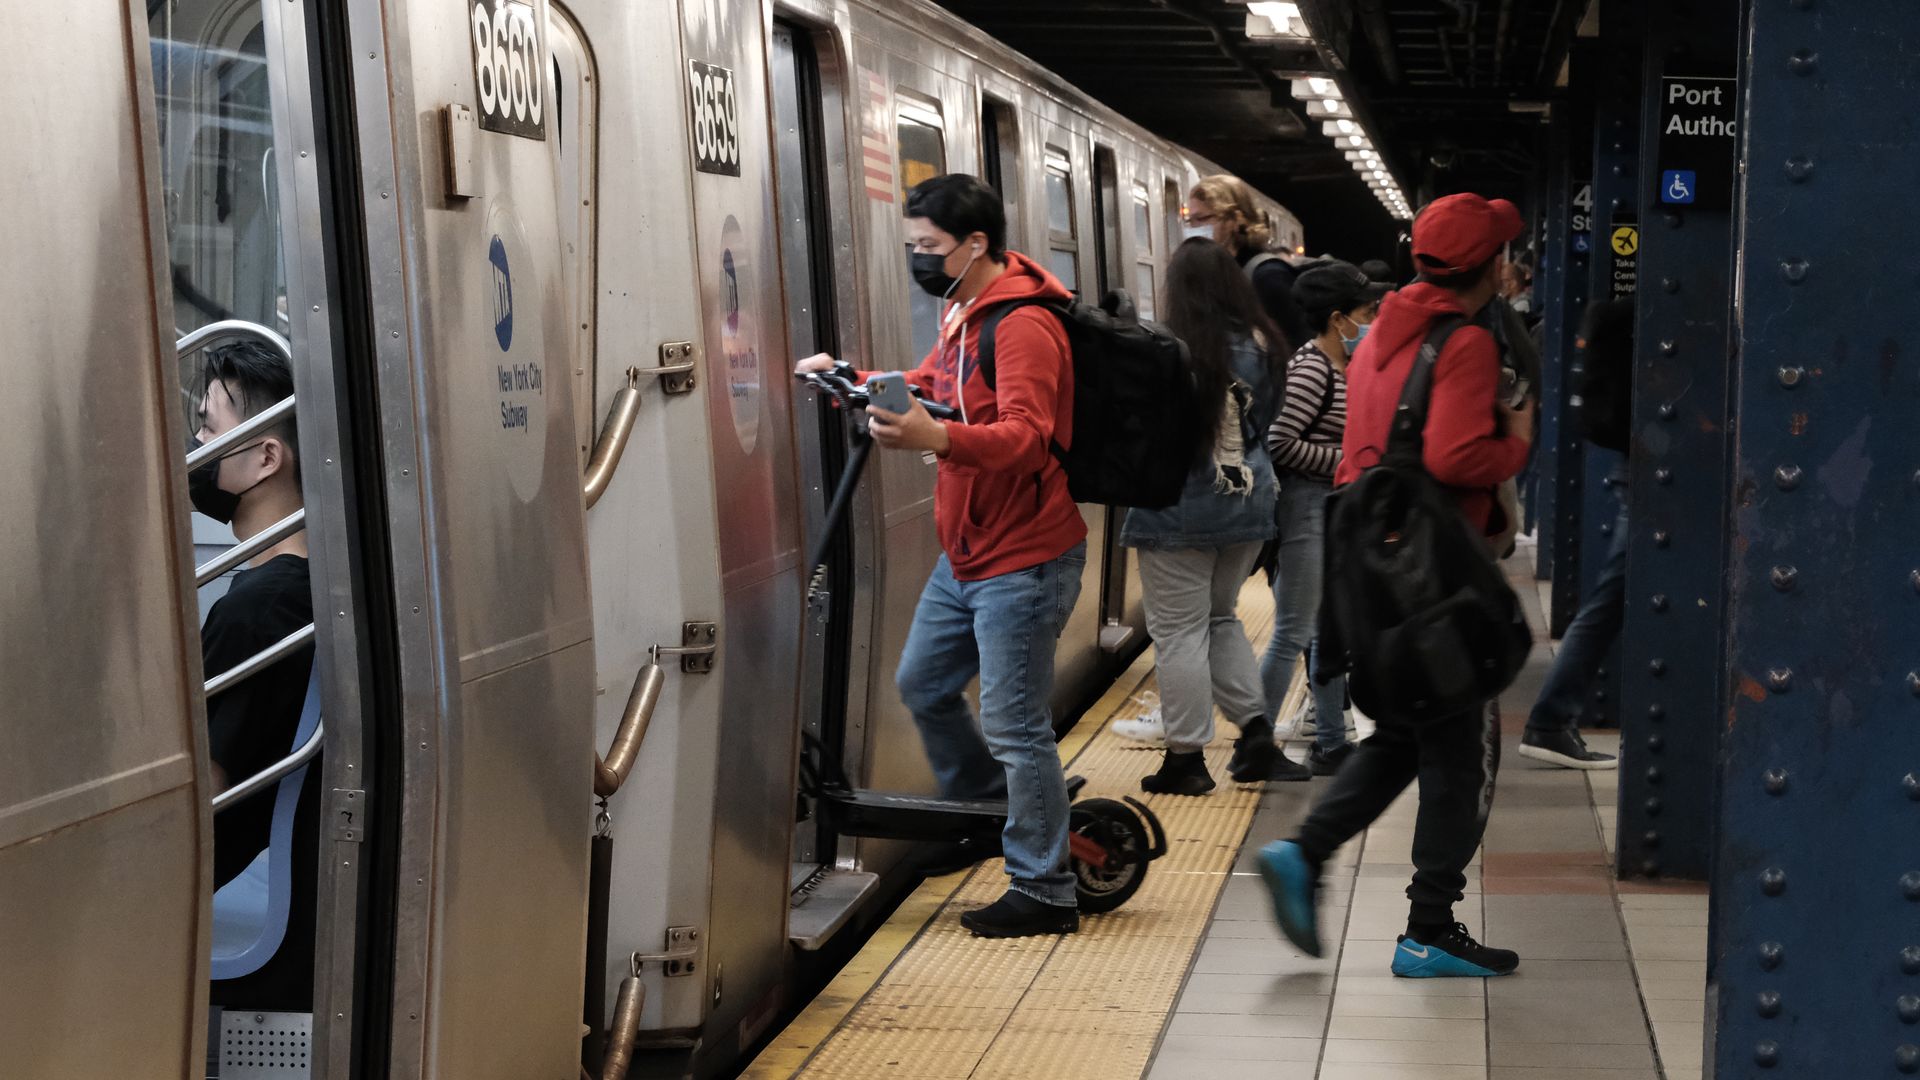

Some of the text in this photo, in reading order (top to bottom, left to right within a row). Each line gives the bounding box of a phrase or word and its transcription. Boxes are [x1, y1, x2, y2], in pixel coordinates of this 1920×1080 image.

[474, 2, 542, 126] 8660
[1669, 84, 1722, 106] Port
[690, 71, 739, 165] 8659
[1665, 114, 1736, 137] Autho
[1573, 184, 1593, 213] 4
[1615, 259, 1636, 268] Take
[498, 362, 542, 395] New York City
[501, 401, 528, 433] Subway
